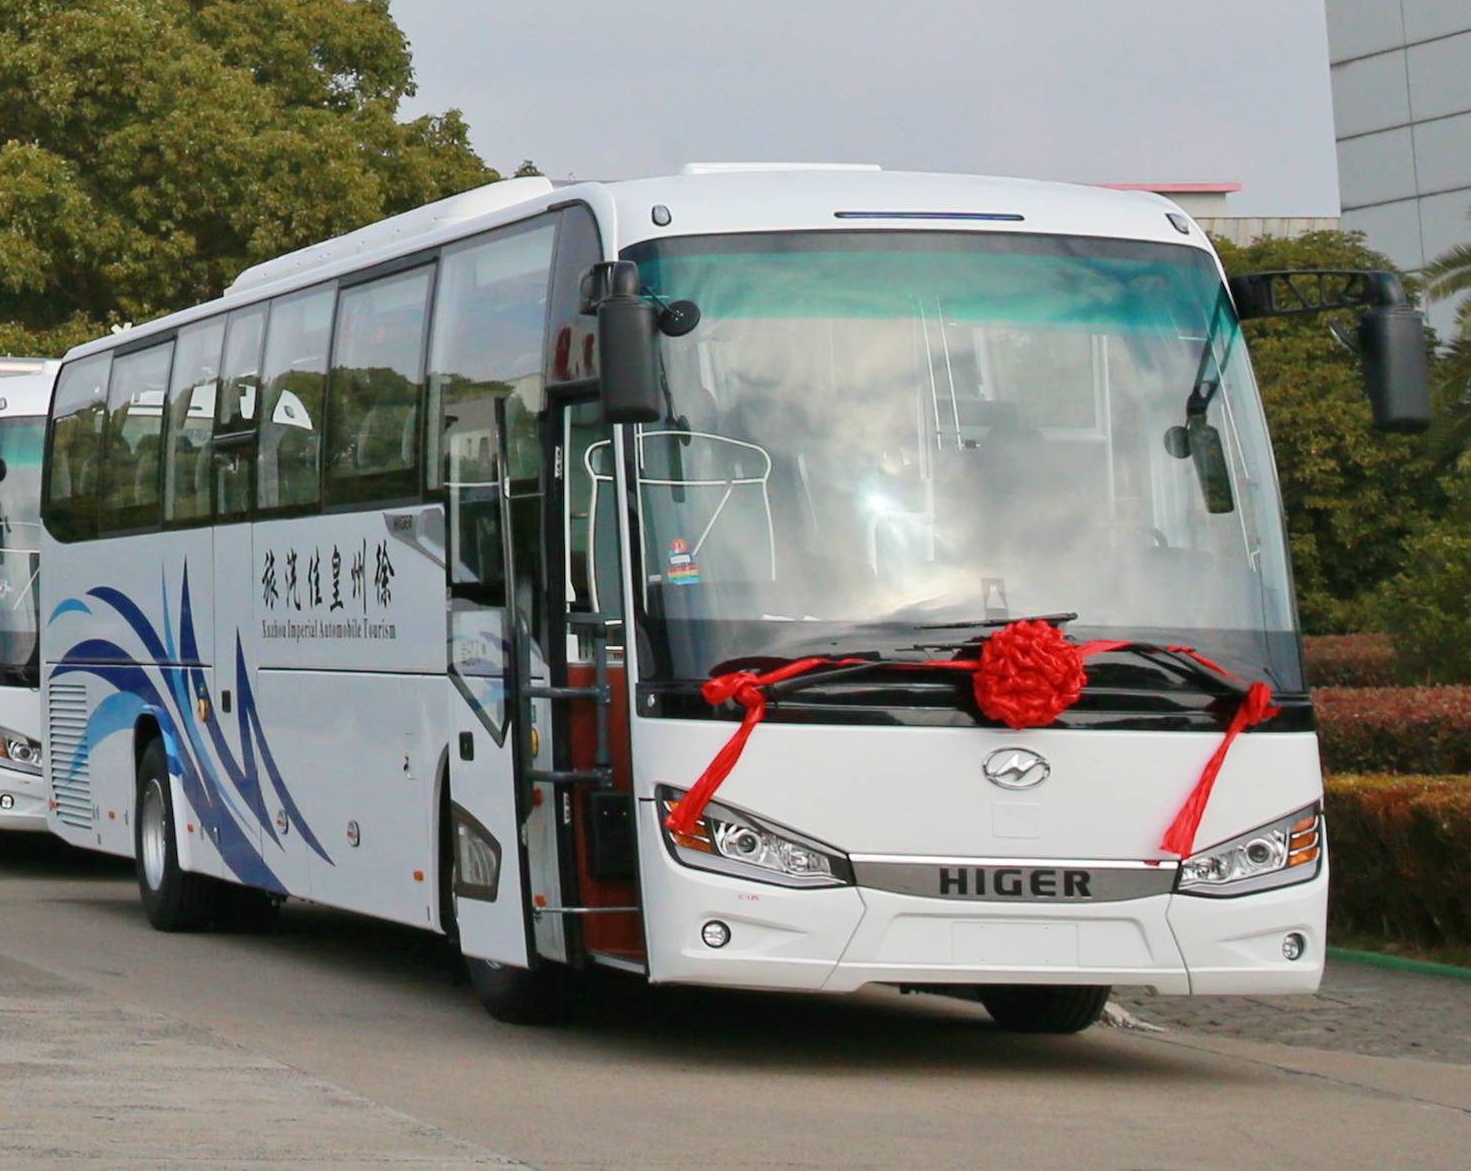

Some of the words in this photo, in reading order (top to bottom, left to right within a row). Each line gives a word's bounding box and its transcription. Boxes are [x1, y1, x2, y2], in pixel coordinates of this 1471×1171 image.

[287, 618, 318, 644] Imperial
[319, 618, 361, 638] Automobile
[363, 617, 396, 639] Tourism
[939, 867, 1092, 897] HIGER
